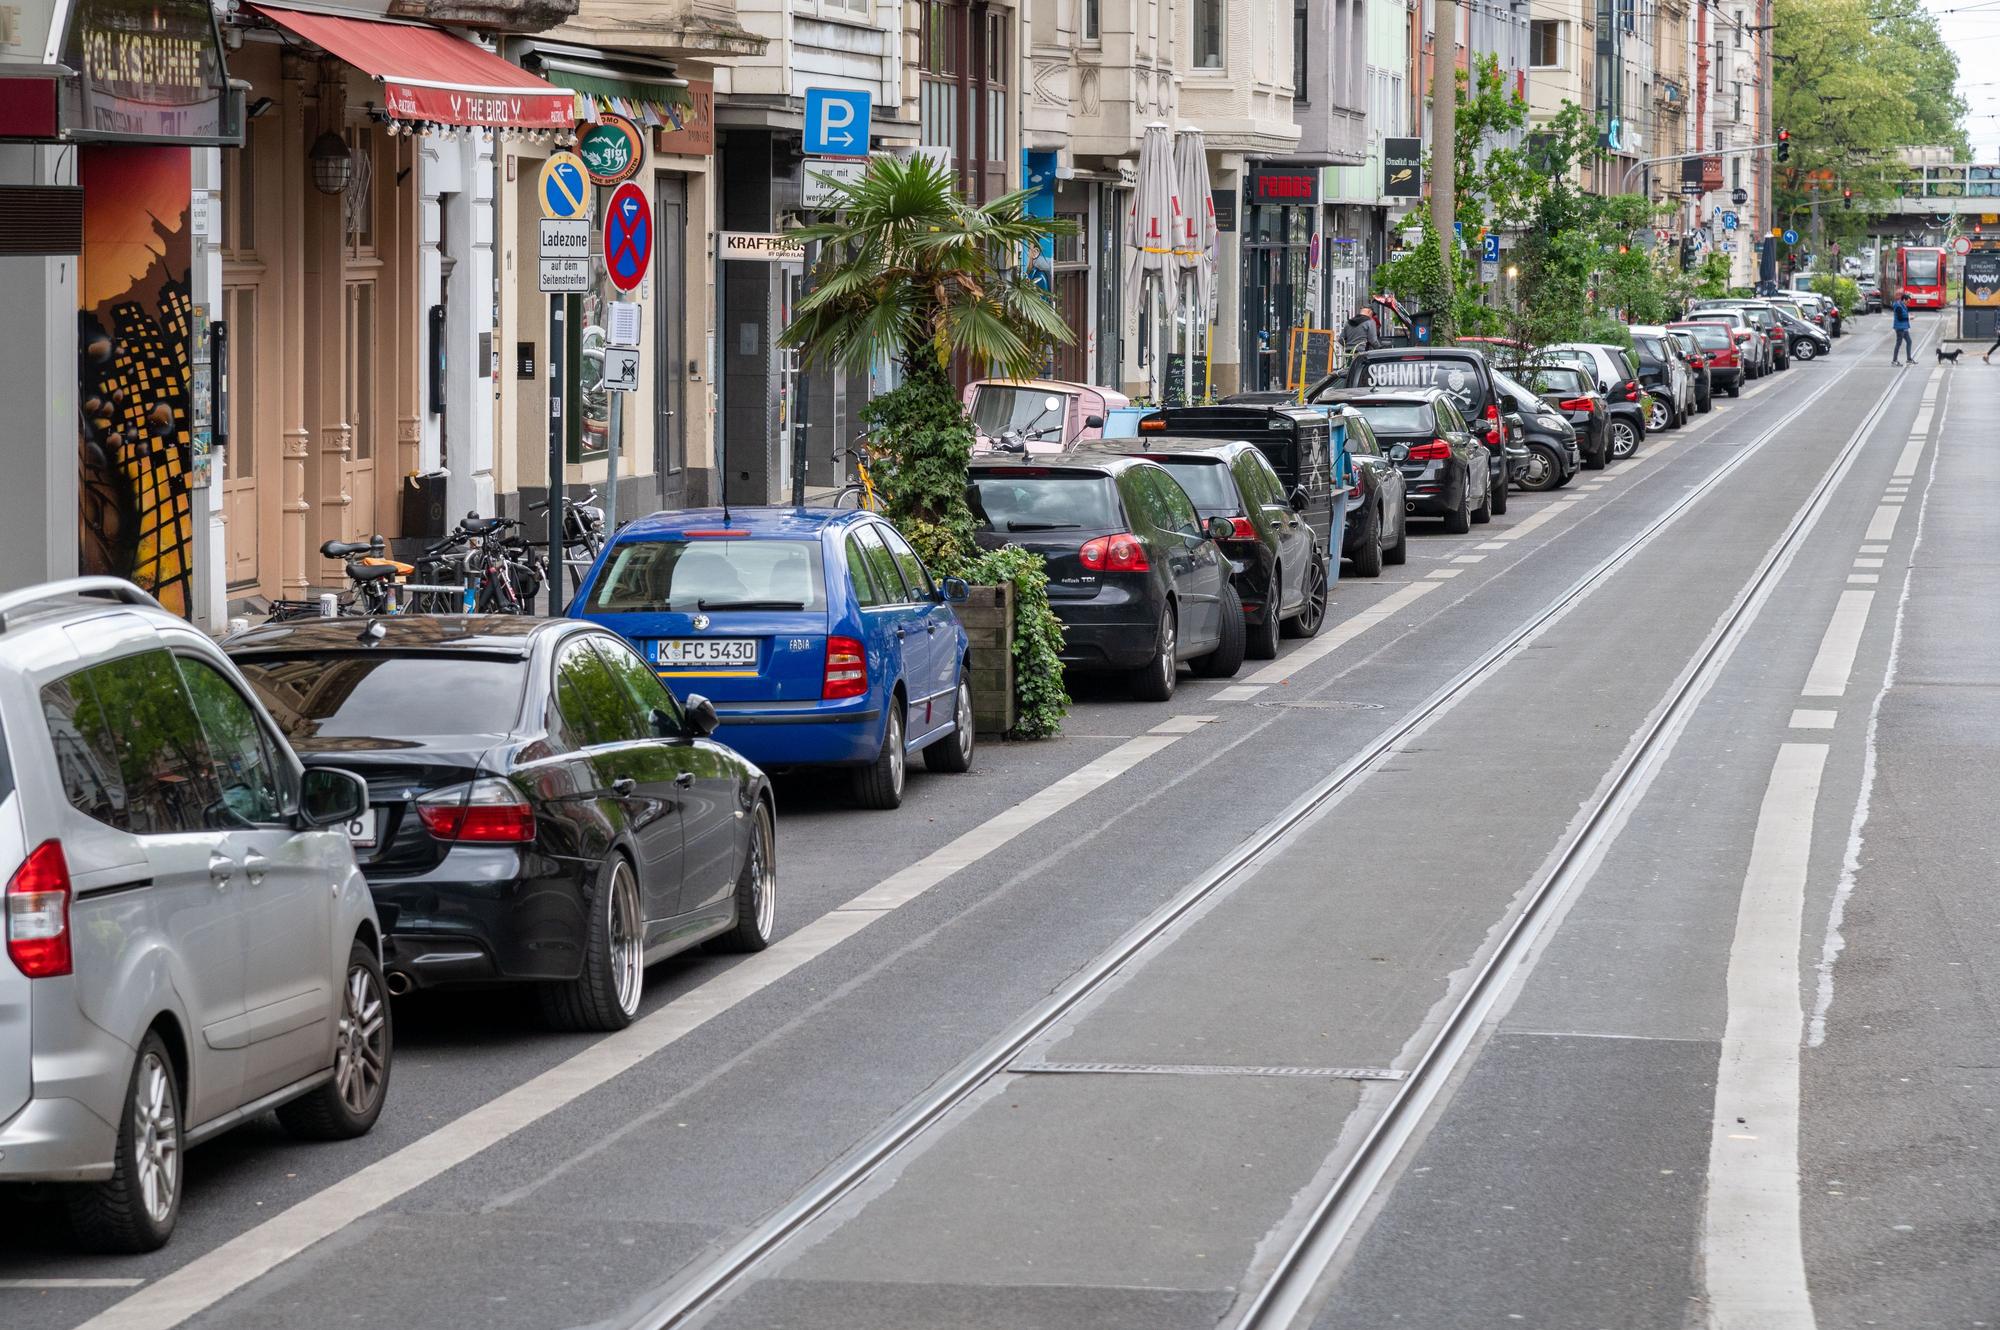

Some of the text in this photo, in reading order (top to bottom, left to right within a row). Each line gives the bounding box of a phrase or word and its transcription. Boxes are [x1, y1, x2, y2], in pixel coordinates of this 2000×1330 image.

[466, 97, 508, 122] THE BIRD
[1386, 157, 1407, 166] Sushi
[822, 168, 849, 177] nur mit
[1258, 175, 1313, 198] remos
[542, 230, 587, 247] Ladezone
[551, 260, 578, 271] auf dem
[542, 274, 586, 285] Seitenstreifen
[1367, 363, 1439, 387] SCHMITZ
[659, 642, 754, 660] K FC 5430
[789, 639, 810, 650] FABIA
